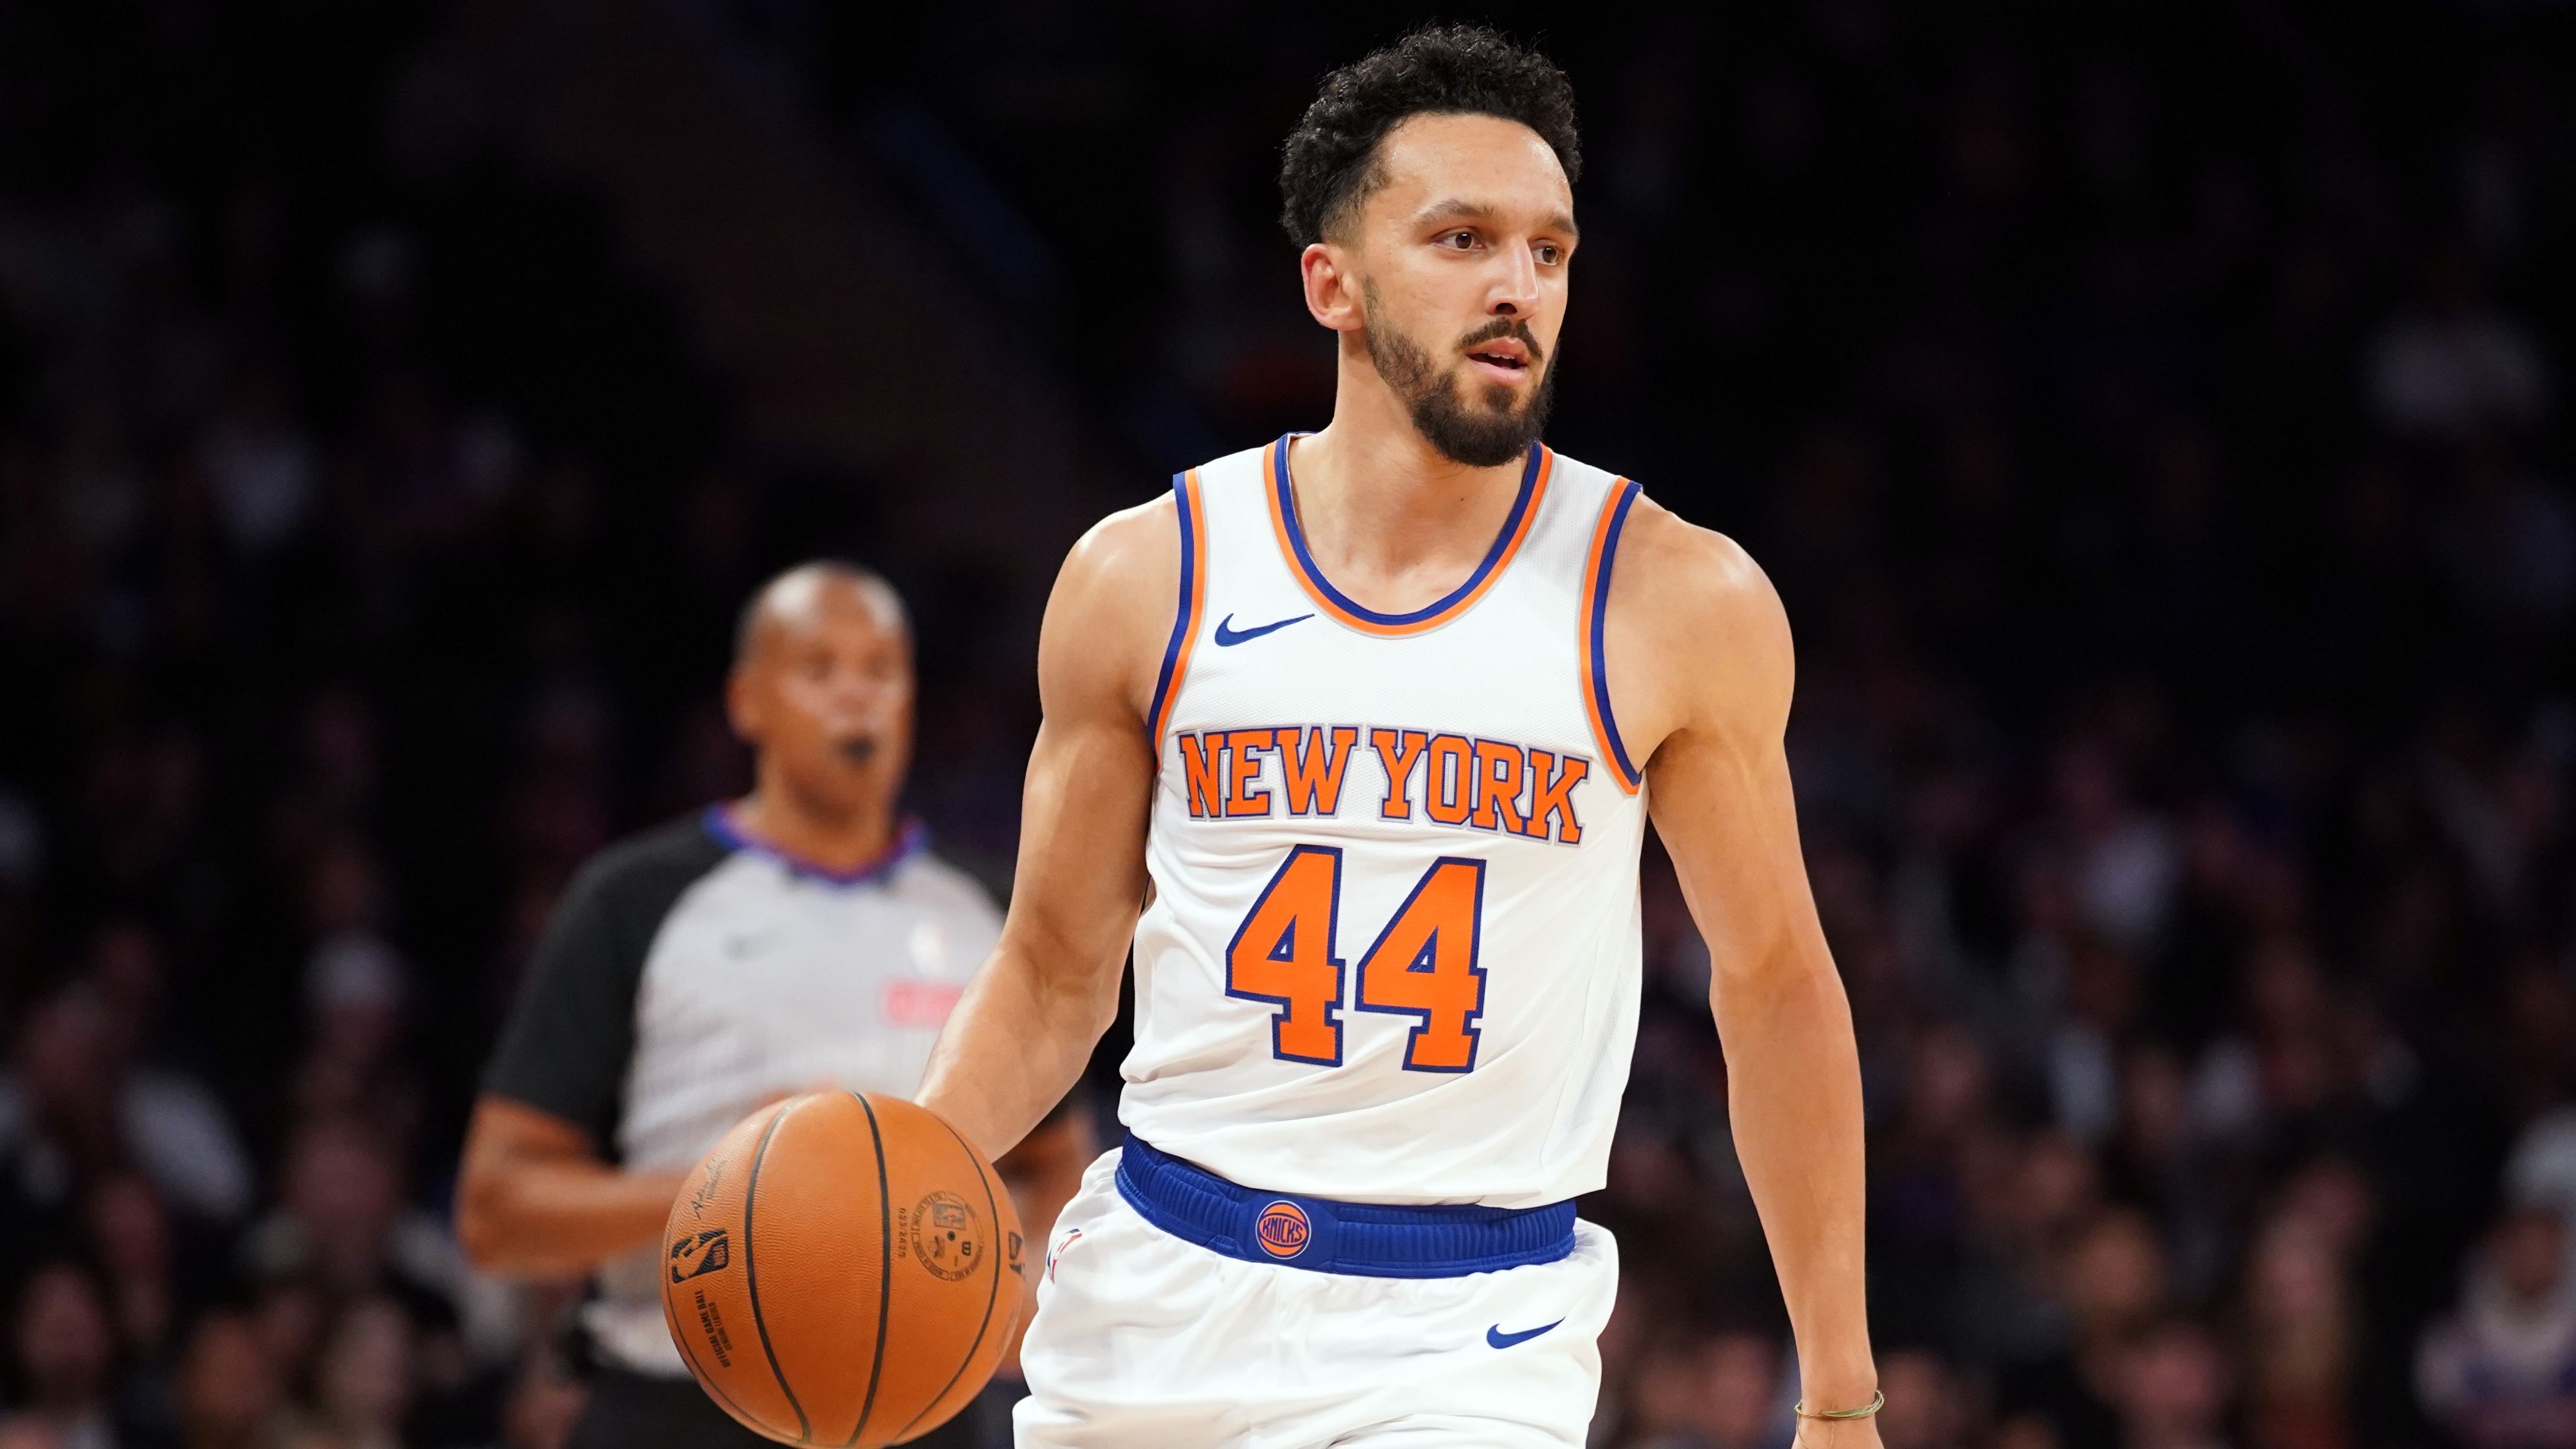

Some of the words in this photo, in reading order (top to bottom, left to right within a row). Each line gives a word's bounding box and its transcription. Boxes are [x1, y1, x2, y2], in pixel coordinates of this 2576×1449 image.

[1177, 724, 1361, 820] NEW
[1368, 727, 1593, 847] YORK
[1225, 844, 1487, 1073] 44
[1262, 1218, 1303, 1243] KNICKS
[694, 1289, 705, 1310] BALL
[699, 1310, 714, 1334] GAME
[708, 1334, 731, 1368] OFFICIAL
